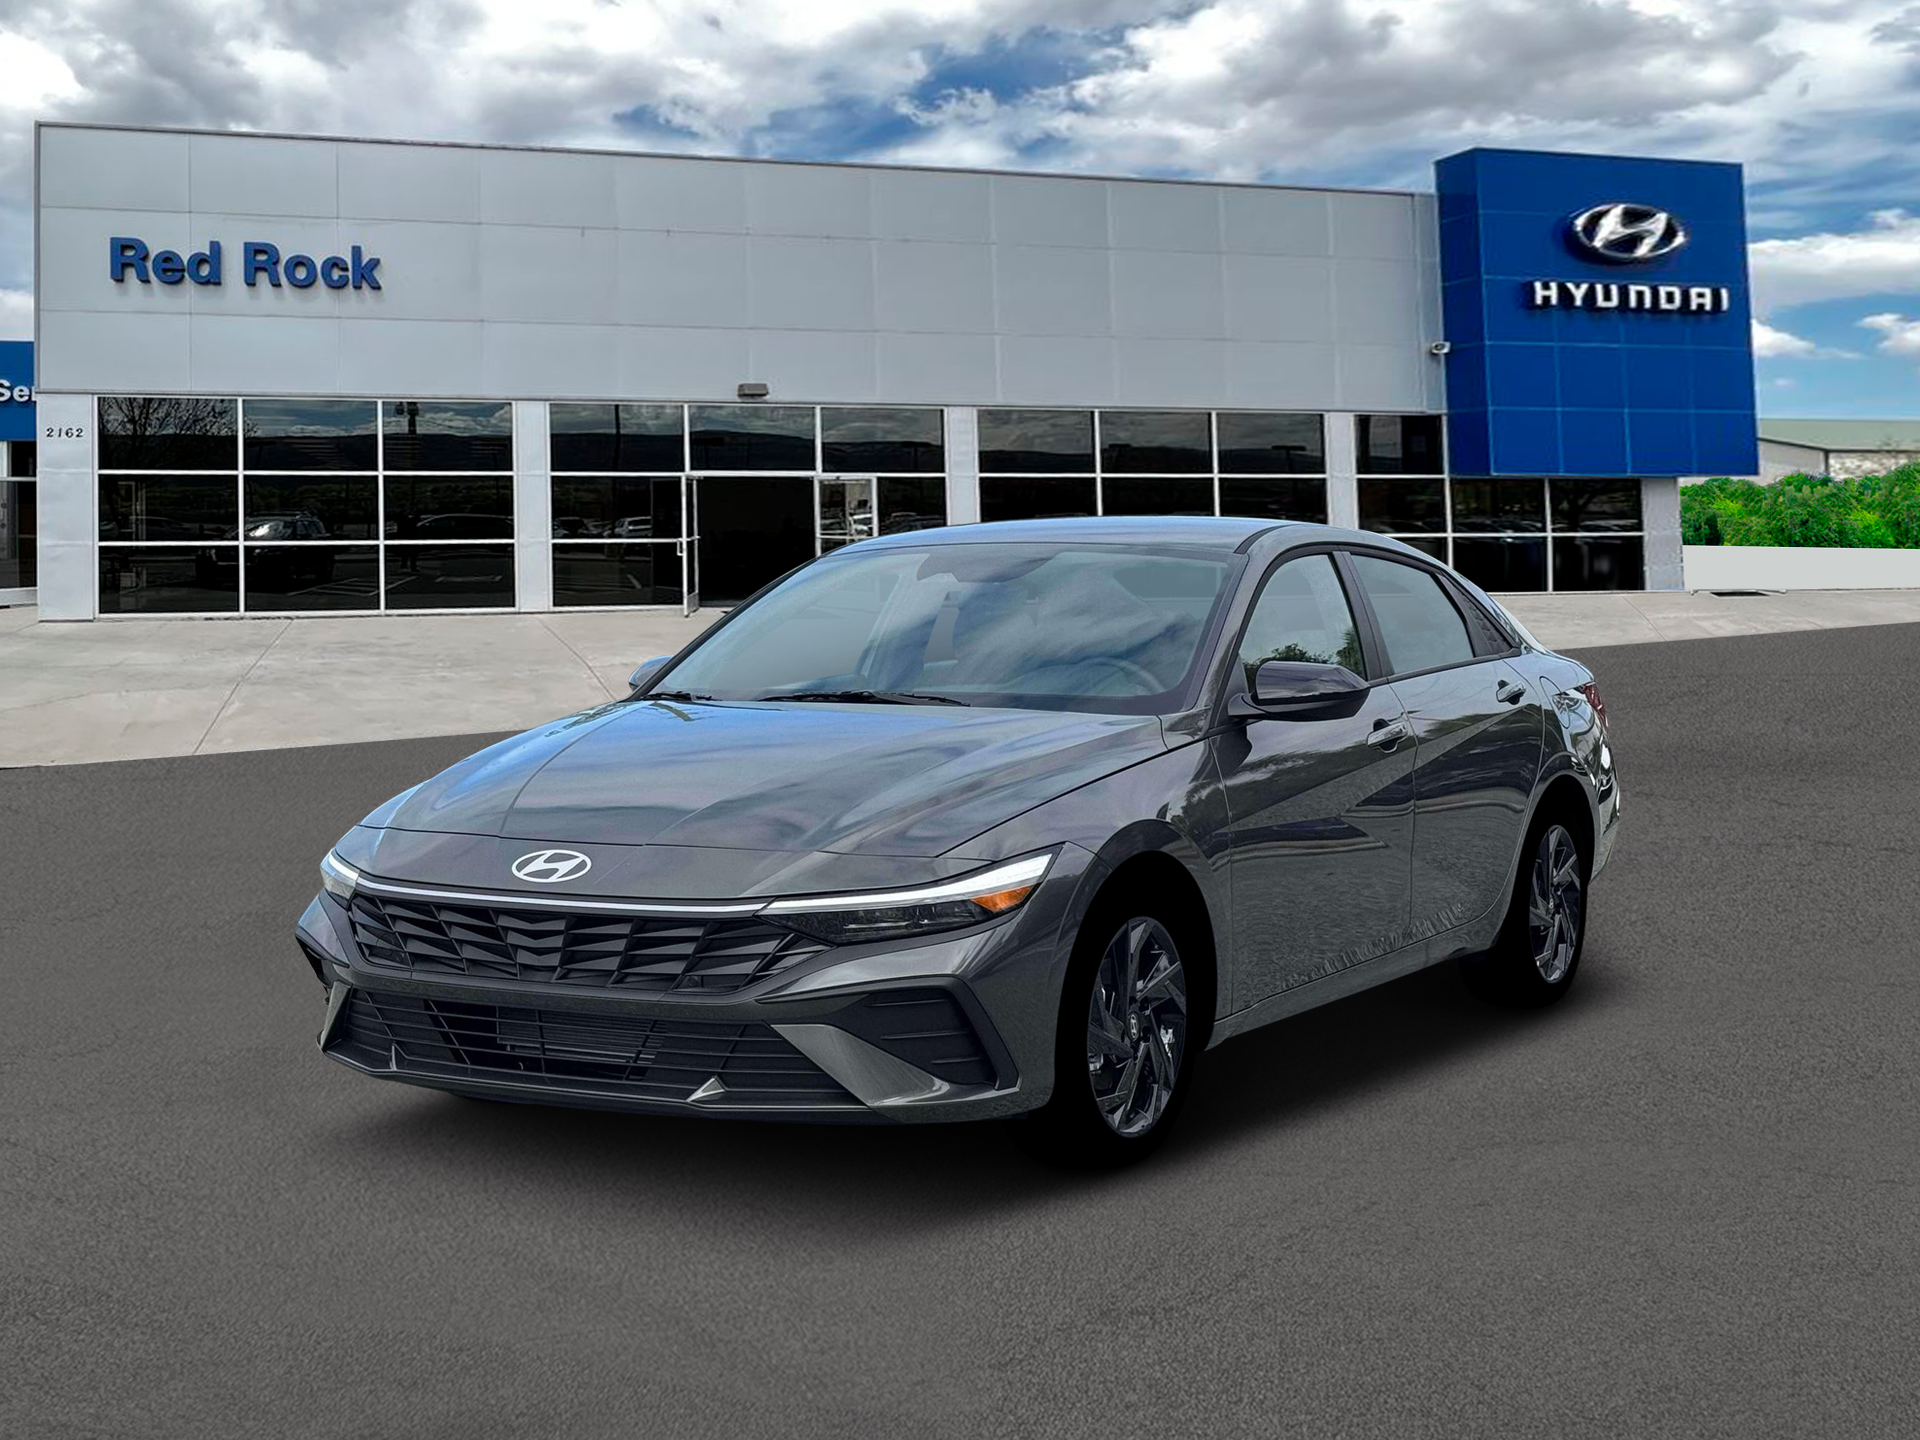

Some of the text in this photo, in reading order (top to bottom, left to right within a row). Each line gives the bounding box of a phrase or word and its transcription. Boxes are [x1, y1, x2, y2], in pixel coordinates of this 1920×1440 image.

[109, 236, 383, 290] Red Rock
[1533, 281, 1729, 311] HYUNDAI
[45, 427, 84, 438] 2162
